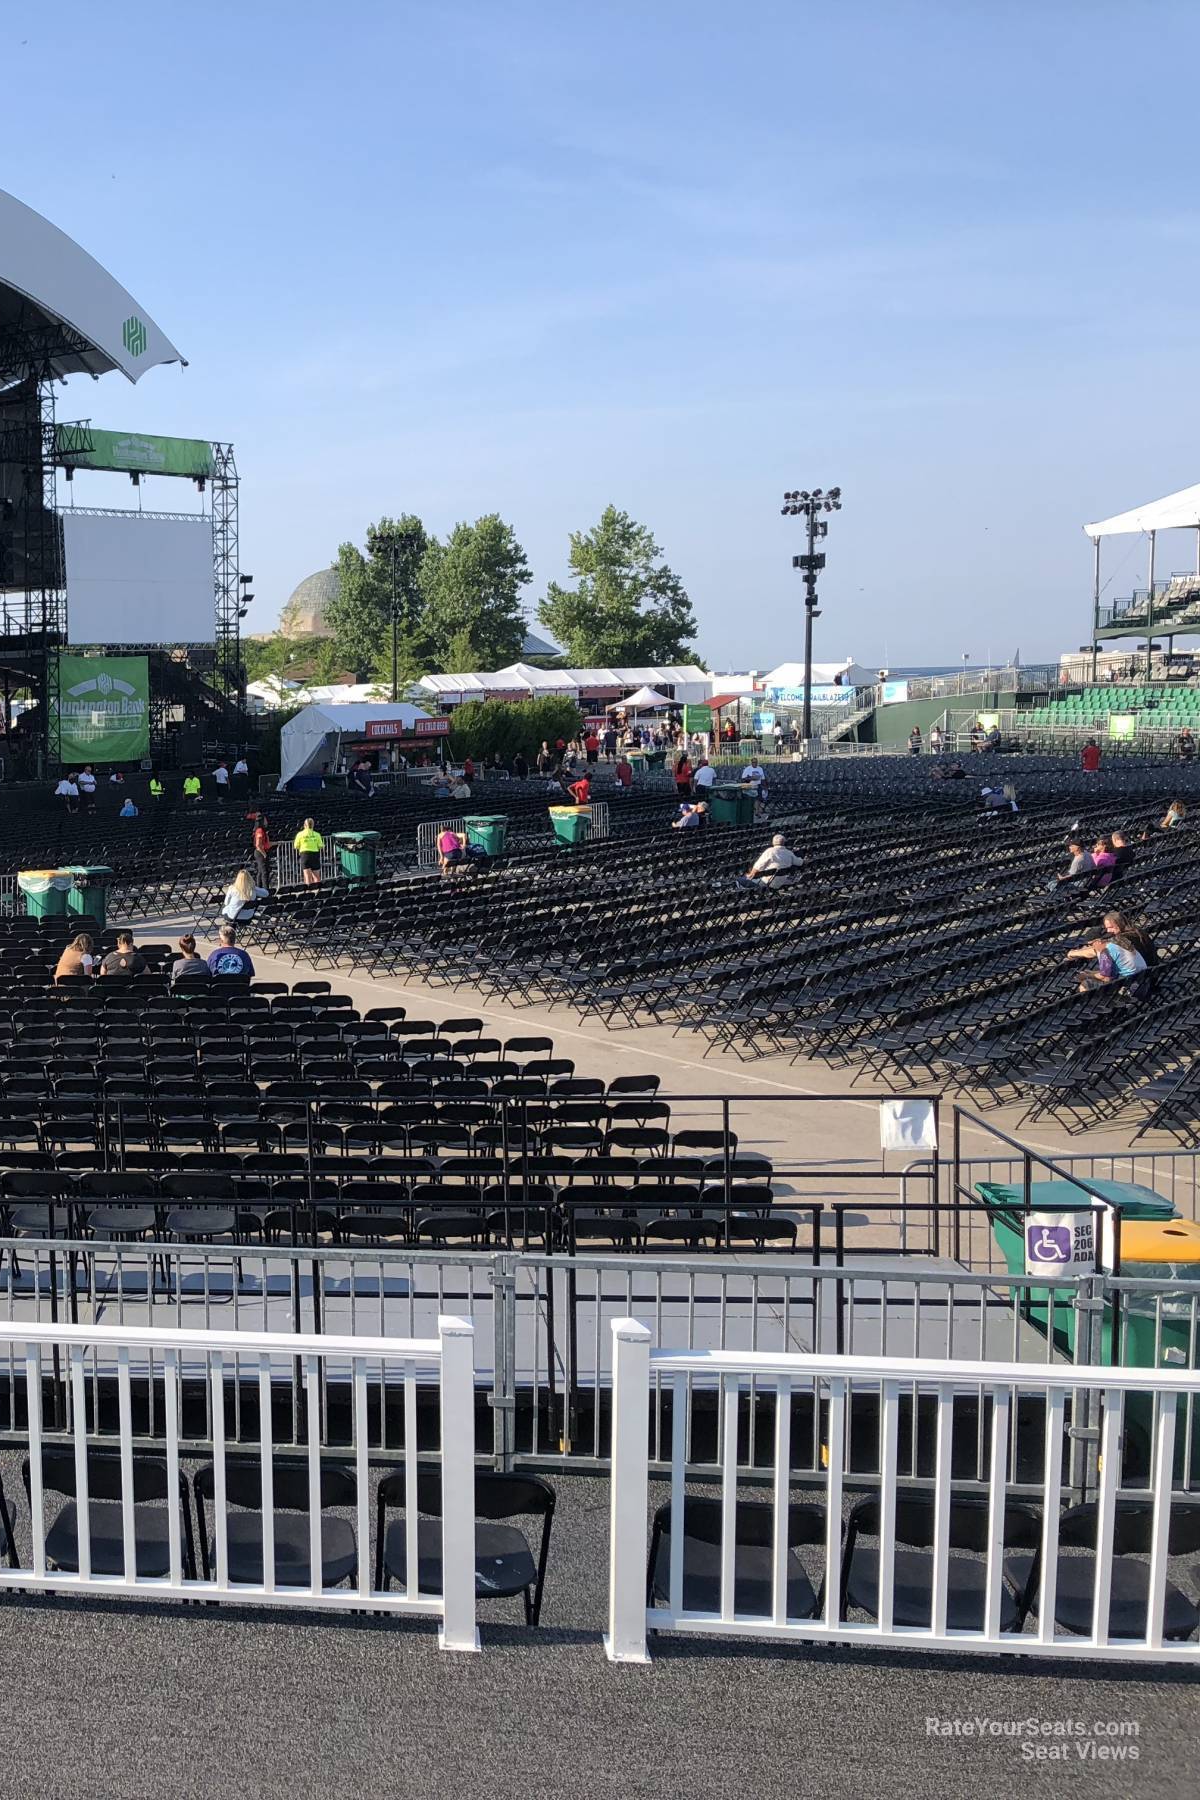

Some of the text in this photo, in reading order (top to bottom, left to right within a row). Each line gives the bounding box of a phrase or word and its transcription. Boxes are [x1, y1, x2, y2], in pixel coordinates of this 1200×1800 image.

[121, 696, 145, 713] Bank
[371, 723, 398, 735] COCKTAILS
[1074, 1224, 1092, 1238] SEC
[1074, 1238, 1093, 1251] 206
[1073, 1250, 1094, 1263] ADA
